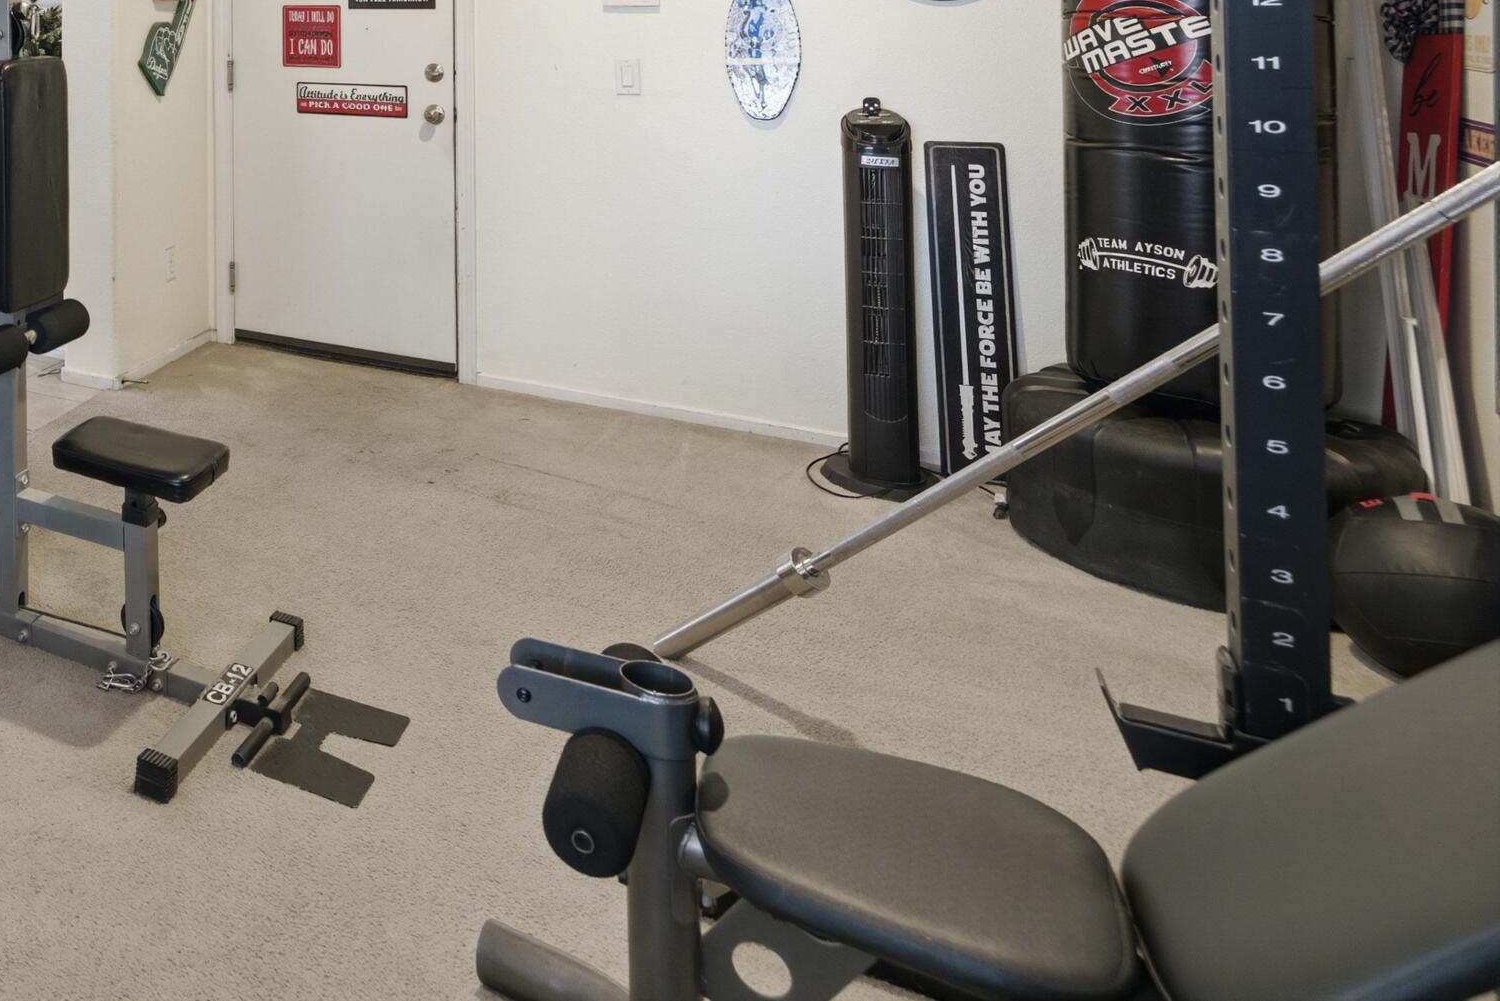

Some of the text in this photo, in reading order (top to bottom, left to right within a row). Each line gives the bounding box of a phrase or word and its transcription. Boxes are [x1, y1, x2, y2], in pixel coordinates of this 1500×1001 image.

[289, 39, 333, 55] I CAN DO
[1064, 17, 1143, 61] WAVE
[1081, 15, 1212, 74] MASTE
[1250, 55, 1281, 70] 11
[299, 85, 404, 103] Attitude is Everything
[1126, 80, 1213, 112] XXL
[308, 101, 330, 109] PICK
[342, 102, 370, 110] GOOD
[373, 104, 393, 112] ONE
[1248, 119, 1287, 135] 10
[968, 163, 987, 211] YOU
[1257, 183, 1282, 199] 9
[971, 211, 992, 264] WITH
[1097, 237, 1186, 261] TEAM AYSON
[1259, 247, 1285, 263] 8
[1103, 257, 1177, 280] ATHLETICS
[975, 268, 993, 296] BE
[1262, 311, 1285, 327] 7
[976, 299, 997, 369] FORCE
[1261, 375, 1287, 390] 6
[980, 372, 1000, 413] THE
[1265, 439, 1290, 455] 5
[1266, 504, 1291, 520] 4
[1270, 568, 1294, 585] 3
[1272, 631, 1295, 648] 2
[206, 663, 252, 704] CB-12
[1279, 697, 1293, 712] 1
